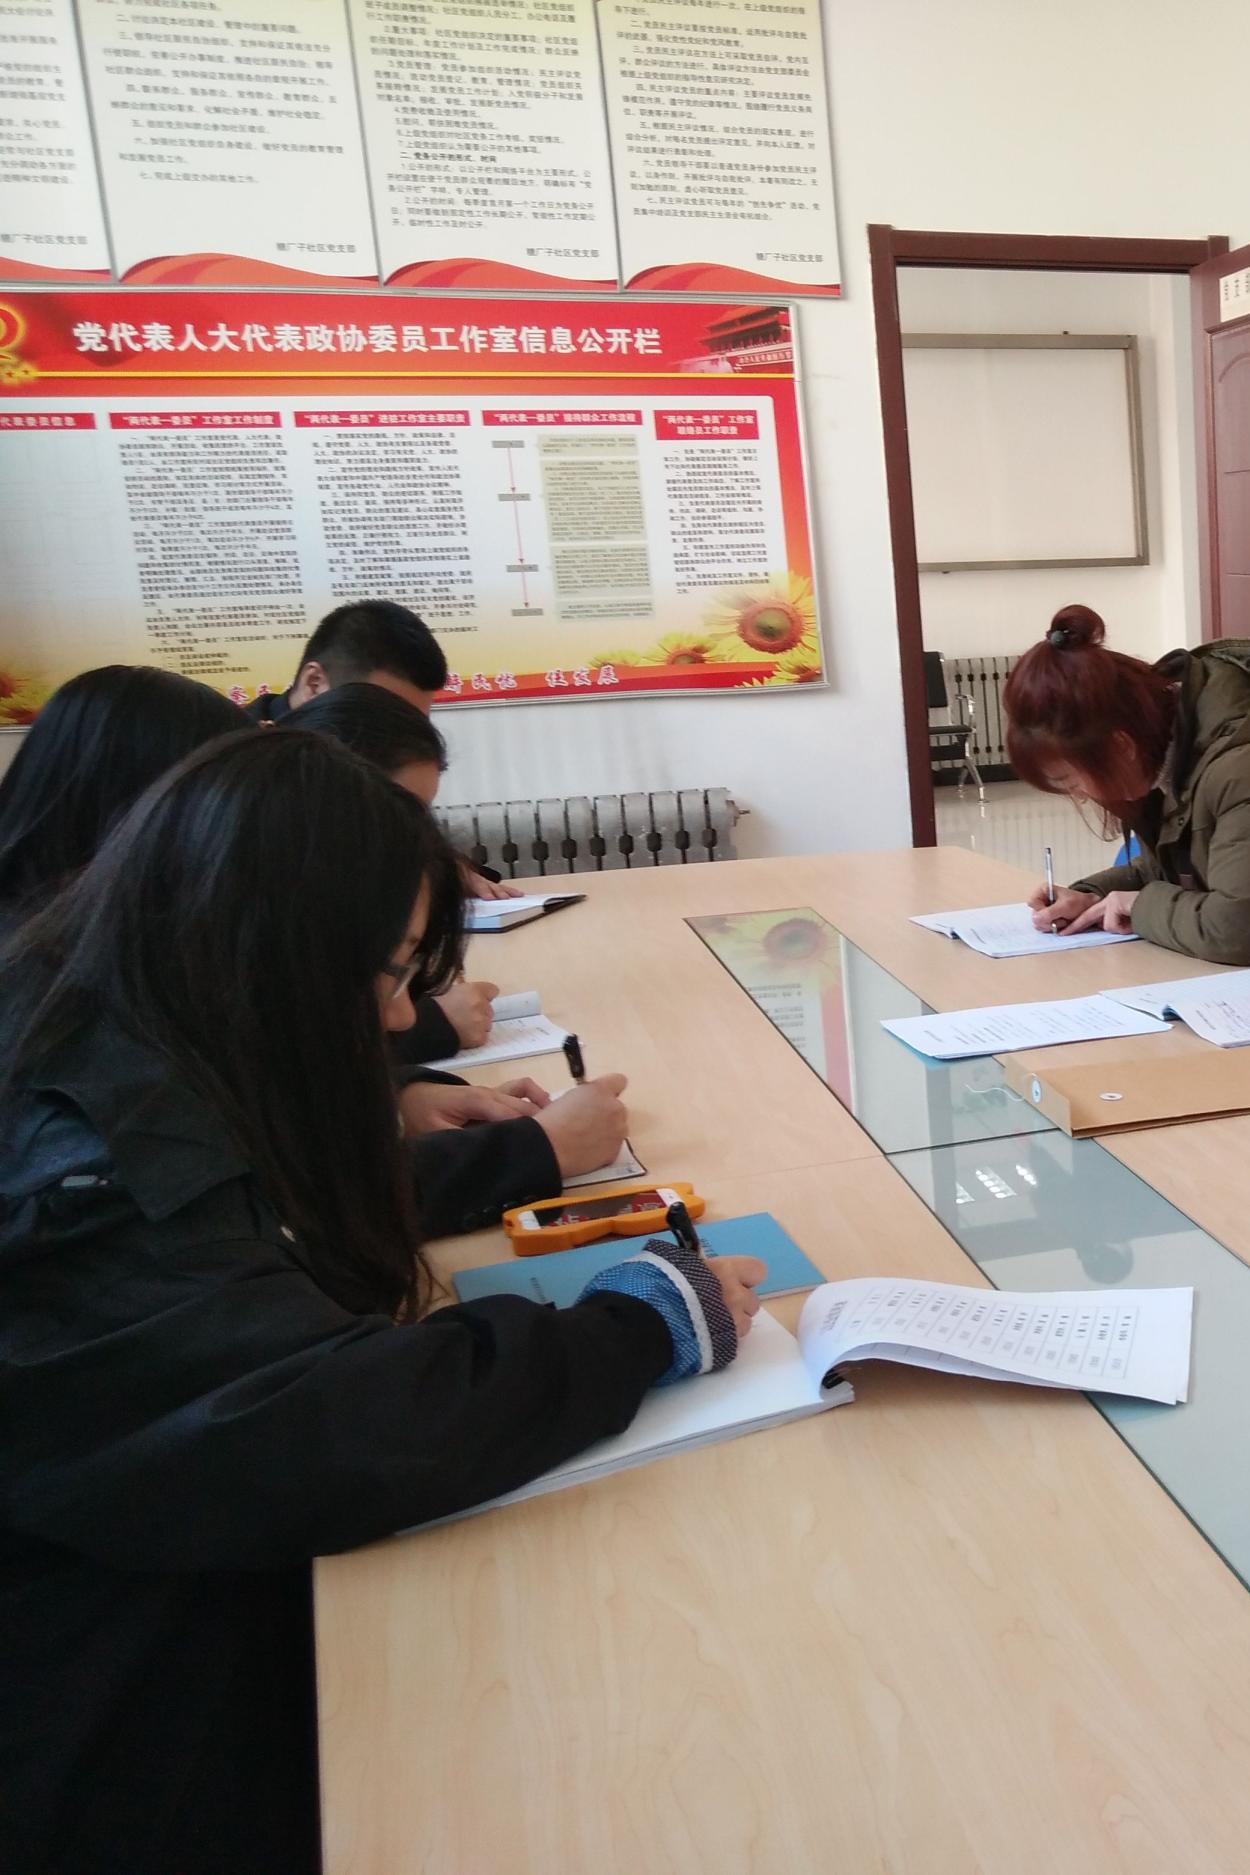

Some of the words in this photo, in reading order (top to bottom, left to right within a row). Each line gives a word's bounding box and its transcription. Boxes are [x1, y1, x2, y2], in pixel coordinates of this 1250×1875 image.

[526, 247, 600, 258] 糖厂子社区党支部
[756, 252, 824, 264] 糖厂子社区党支部
[72, 320, 664, 356] 党代表人大代表政协委员工作室信息公开栏
